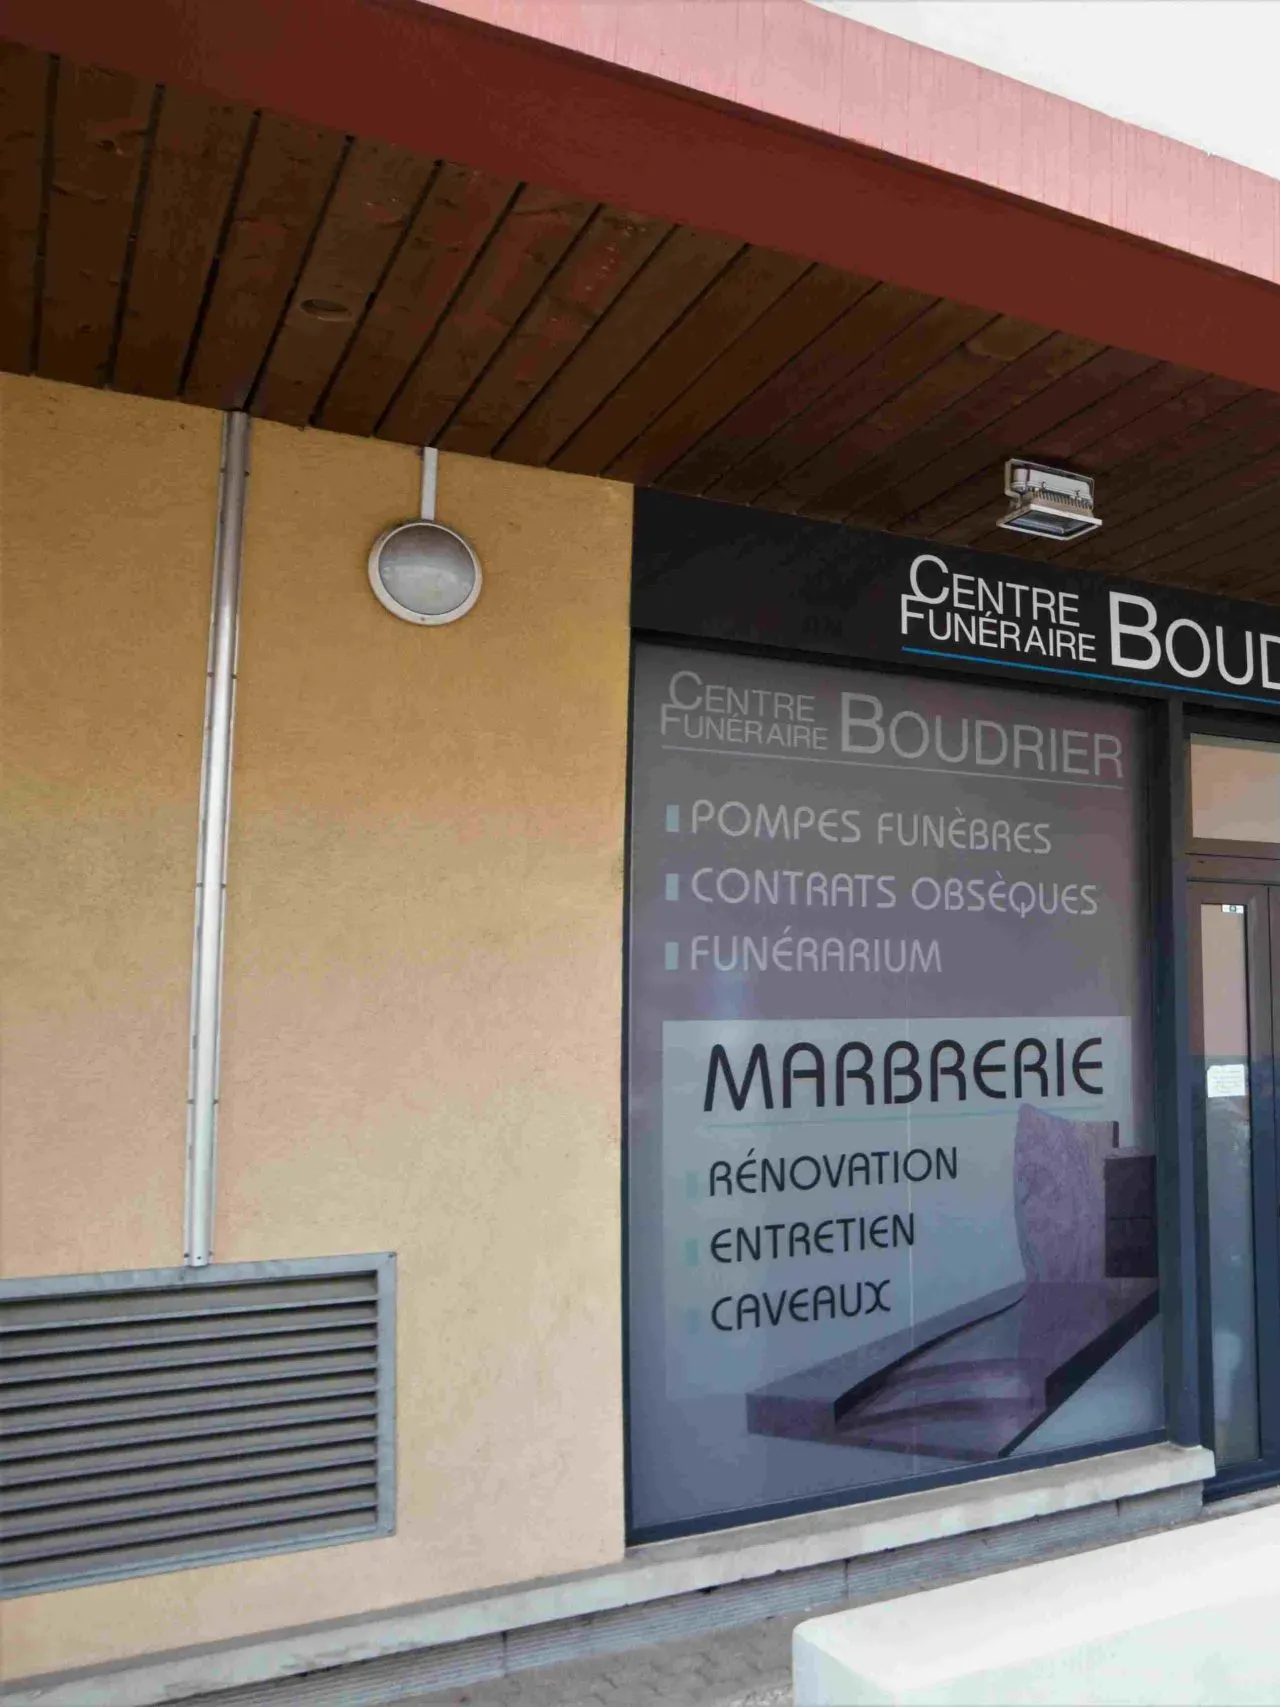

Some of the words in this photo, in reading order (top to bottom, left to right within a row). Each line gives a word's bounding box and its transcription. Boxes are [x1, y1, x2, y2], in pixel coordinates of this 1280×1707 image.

[909, 555, 1080, 627] CENTRE
[900, 593, 1097, 663] FUNÉRAIRE
[669, 671, 815, 722] CENTRE
[660, 703, 827, 750] FUNÉRAIRE
[841, 692, 1123, 778] BOUDRIER
[691, 800, 861, 843] POMPES
[878, 807, 1051, 854] FUNÈBRES
[691, 867, 896, 908] CONTRATS
[911, 872, 1097, 918] OBSÈQUES
[691, 927, 942, 972] FUNÉRARIUM
[703, 1037, 1103, 1112] MARBRERIE
[710, 1147, 957, 1196] RÉNOVATION
[710, 1213, 914, 1264] ENTRETIEN
[710, 1280, 890, 1331] CAVEAUX
